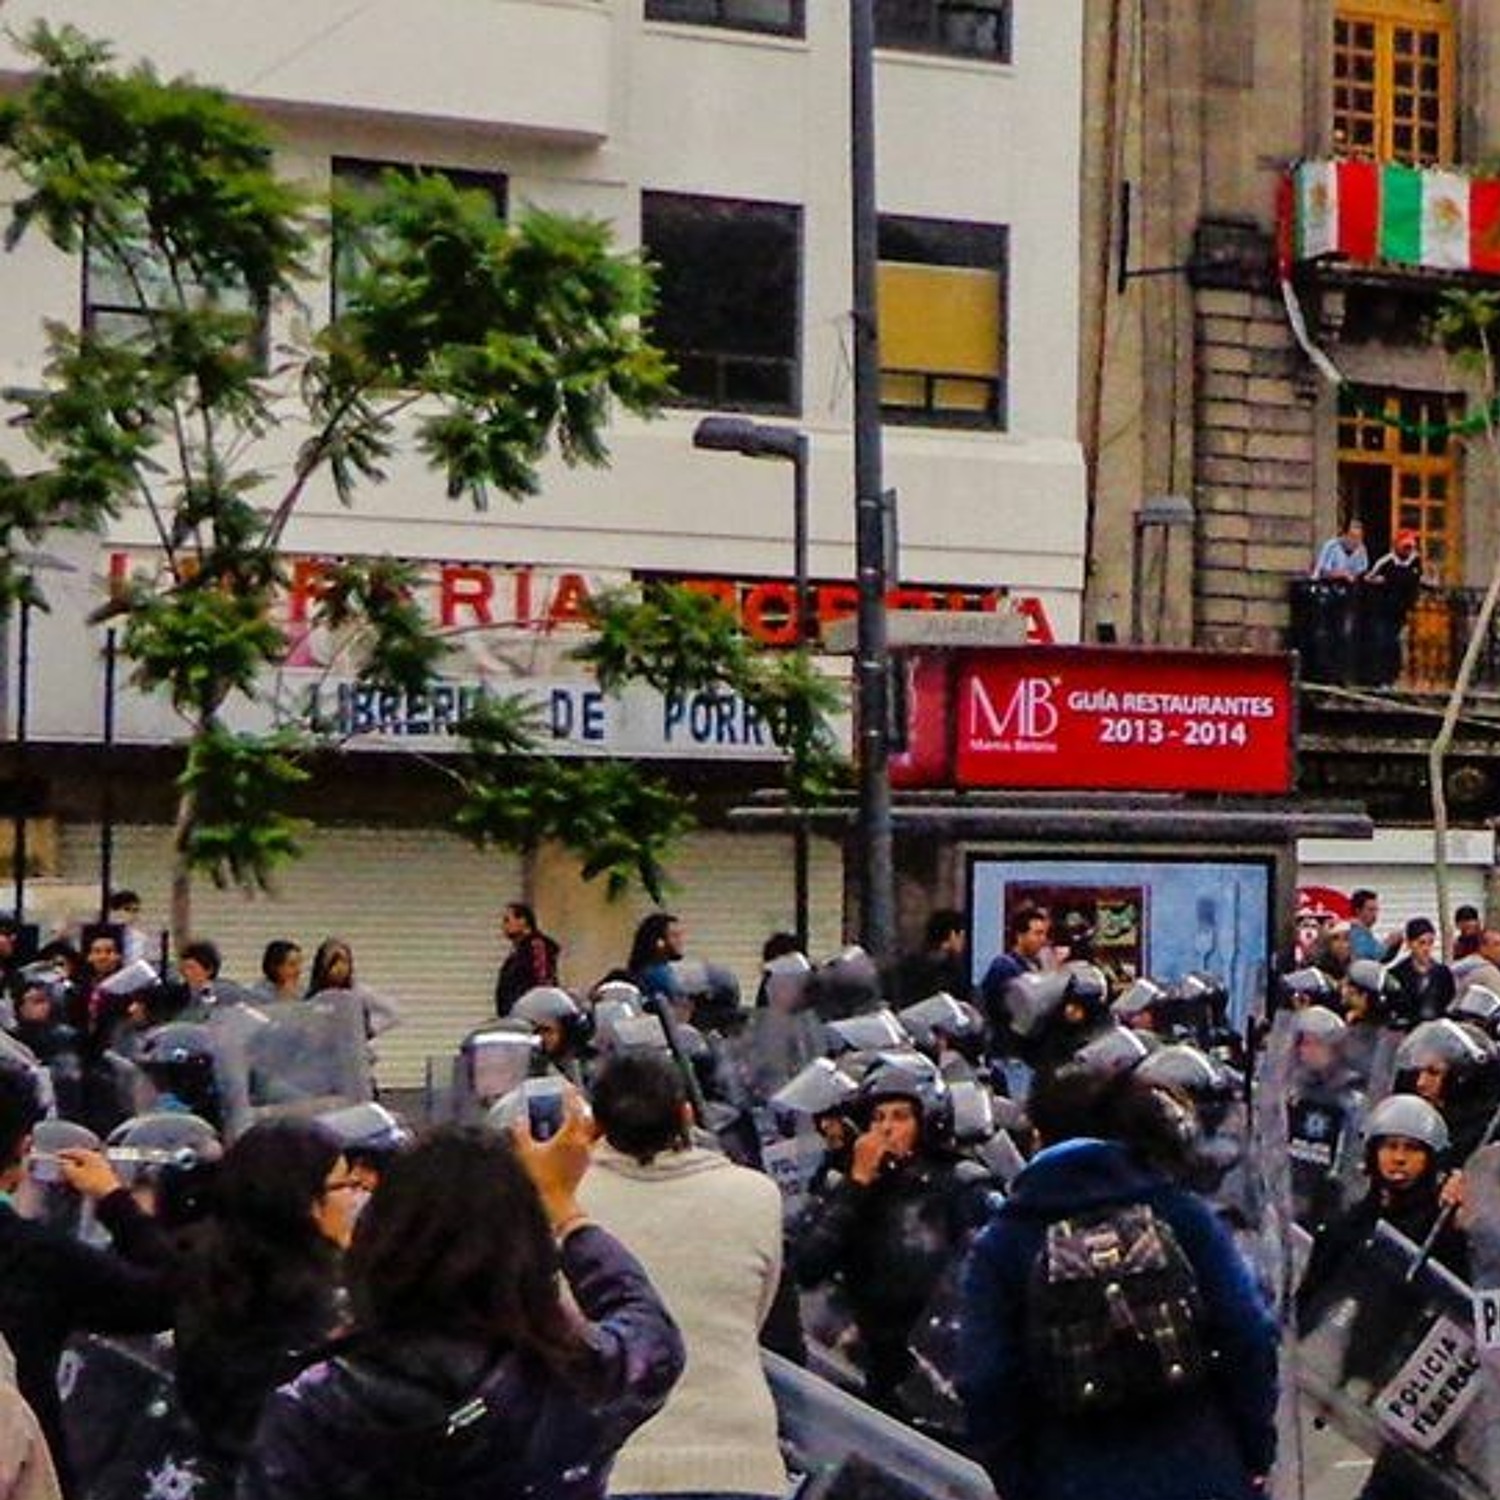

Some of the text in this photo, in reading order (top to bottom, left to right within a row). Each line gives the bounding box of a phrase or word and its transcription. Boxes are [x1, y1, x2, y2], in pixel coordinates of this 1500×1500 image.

[550, 688, 606, 741] DE
[970, 675, 1059, 738] MB
[1067, 688, 1274, 718] GUÍA RESTAURANTES
[1100, 717, 1163, 743] 2013
[1183, 721, 1247, 745] 2014
[1389, 1337, 1457, 1418] POLICIA
